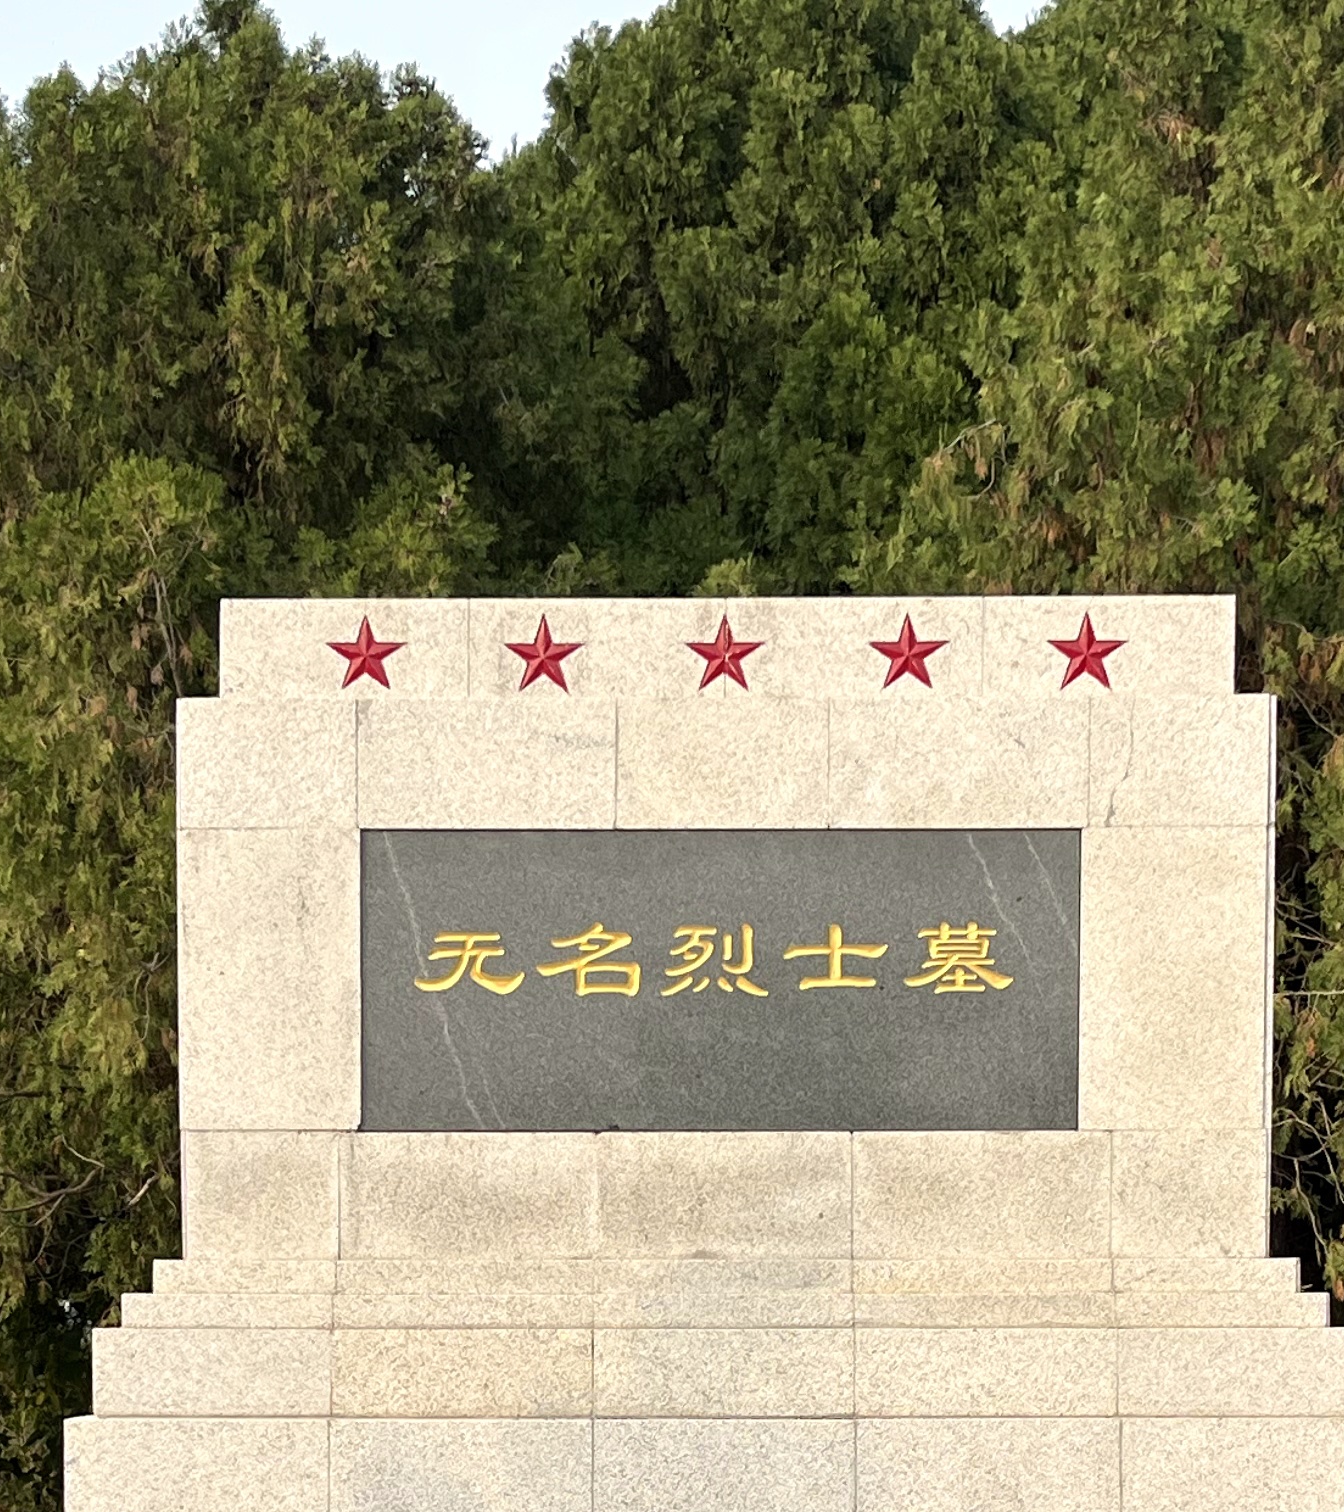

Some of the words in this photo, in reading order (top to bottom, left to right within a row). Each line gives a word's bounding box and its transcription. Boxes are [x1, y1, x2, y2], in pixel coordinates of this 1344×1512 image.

[414, 921, 1015, 998] 无名烈士墓
